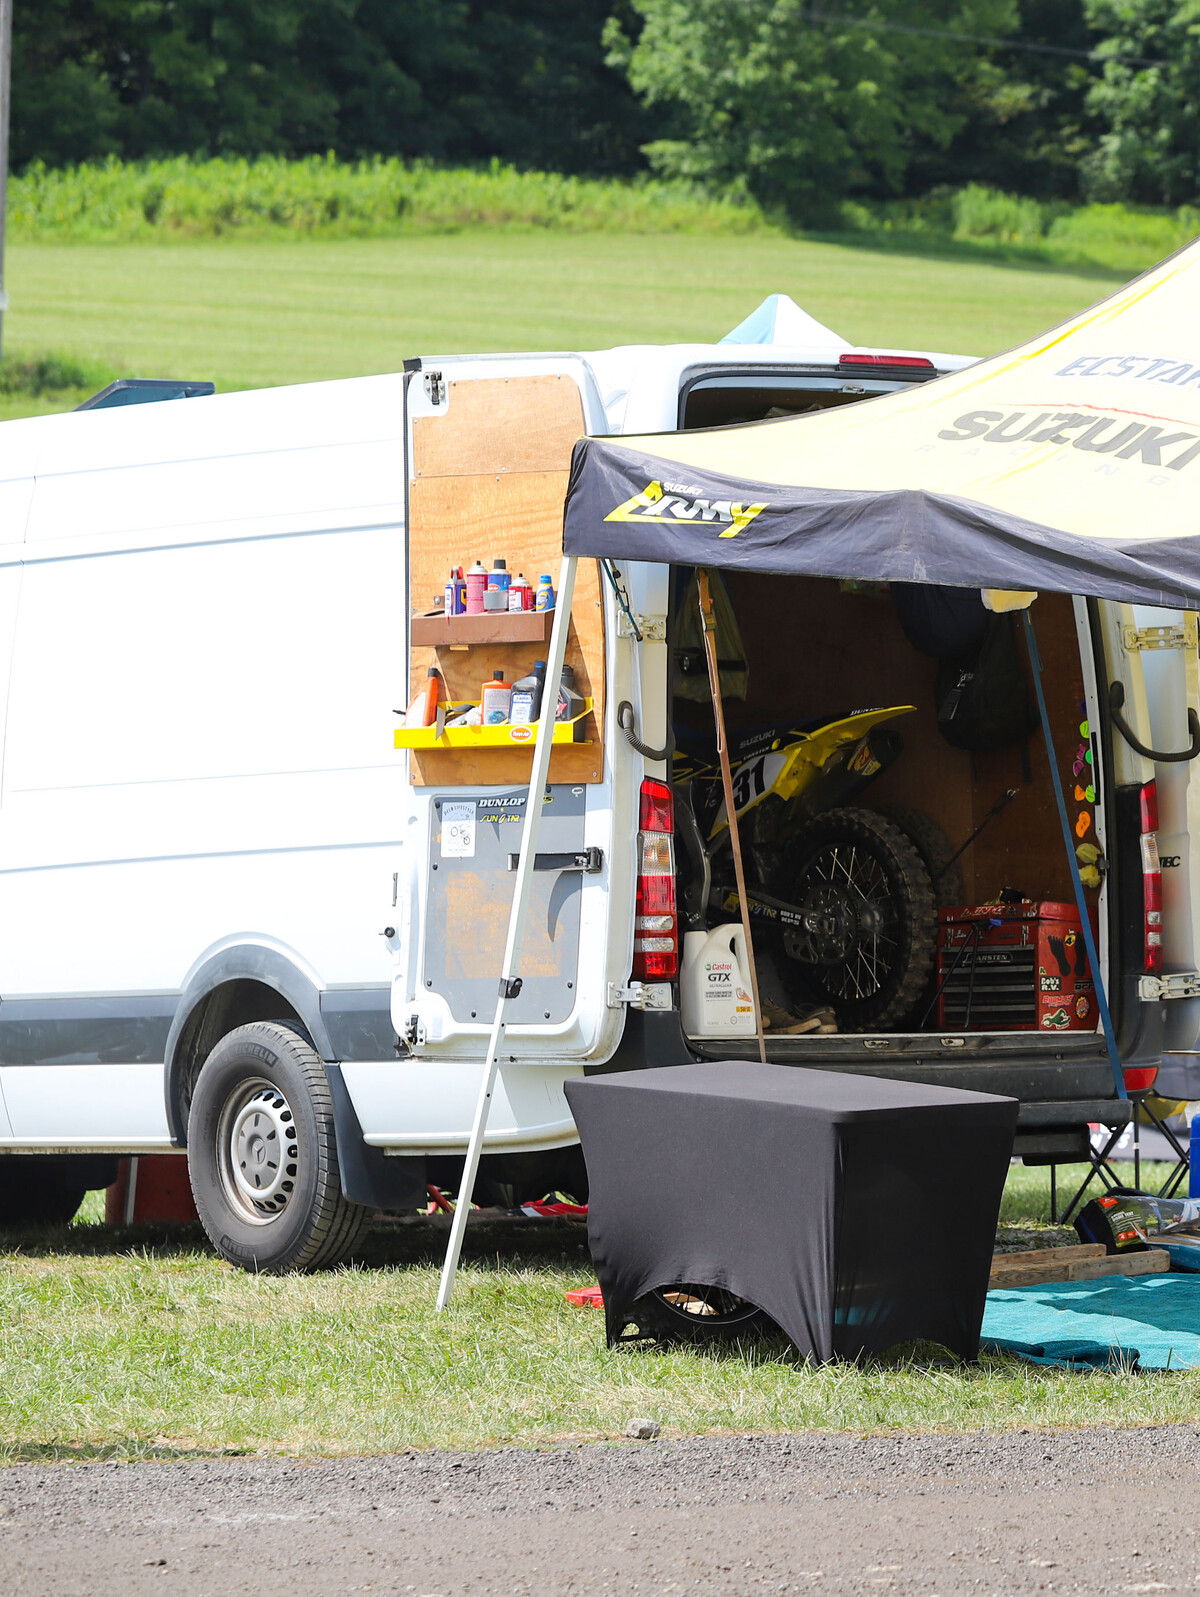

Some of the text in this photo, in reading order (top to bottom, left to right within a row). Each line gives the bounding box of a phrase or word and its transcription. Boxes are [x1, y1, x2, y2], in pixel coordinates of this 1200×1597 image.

[663, 481, 703, 496] SUZUKI
[739, 728, 776, 749] SUZUKI
[478, 797, 526, 808] DUNLOP
[711, 963, 732, 971] Castrol
[708, 973, 731, 982] GTX
